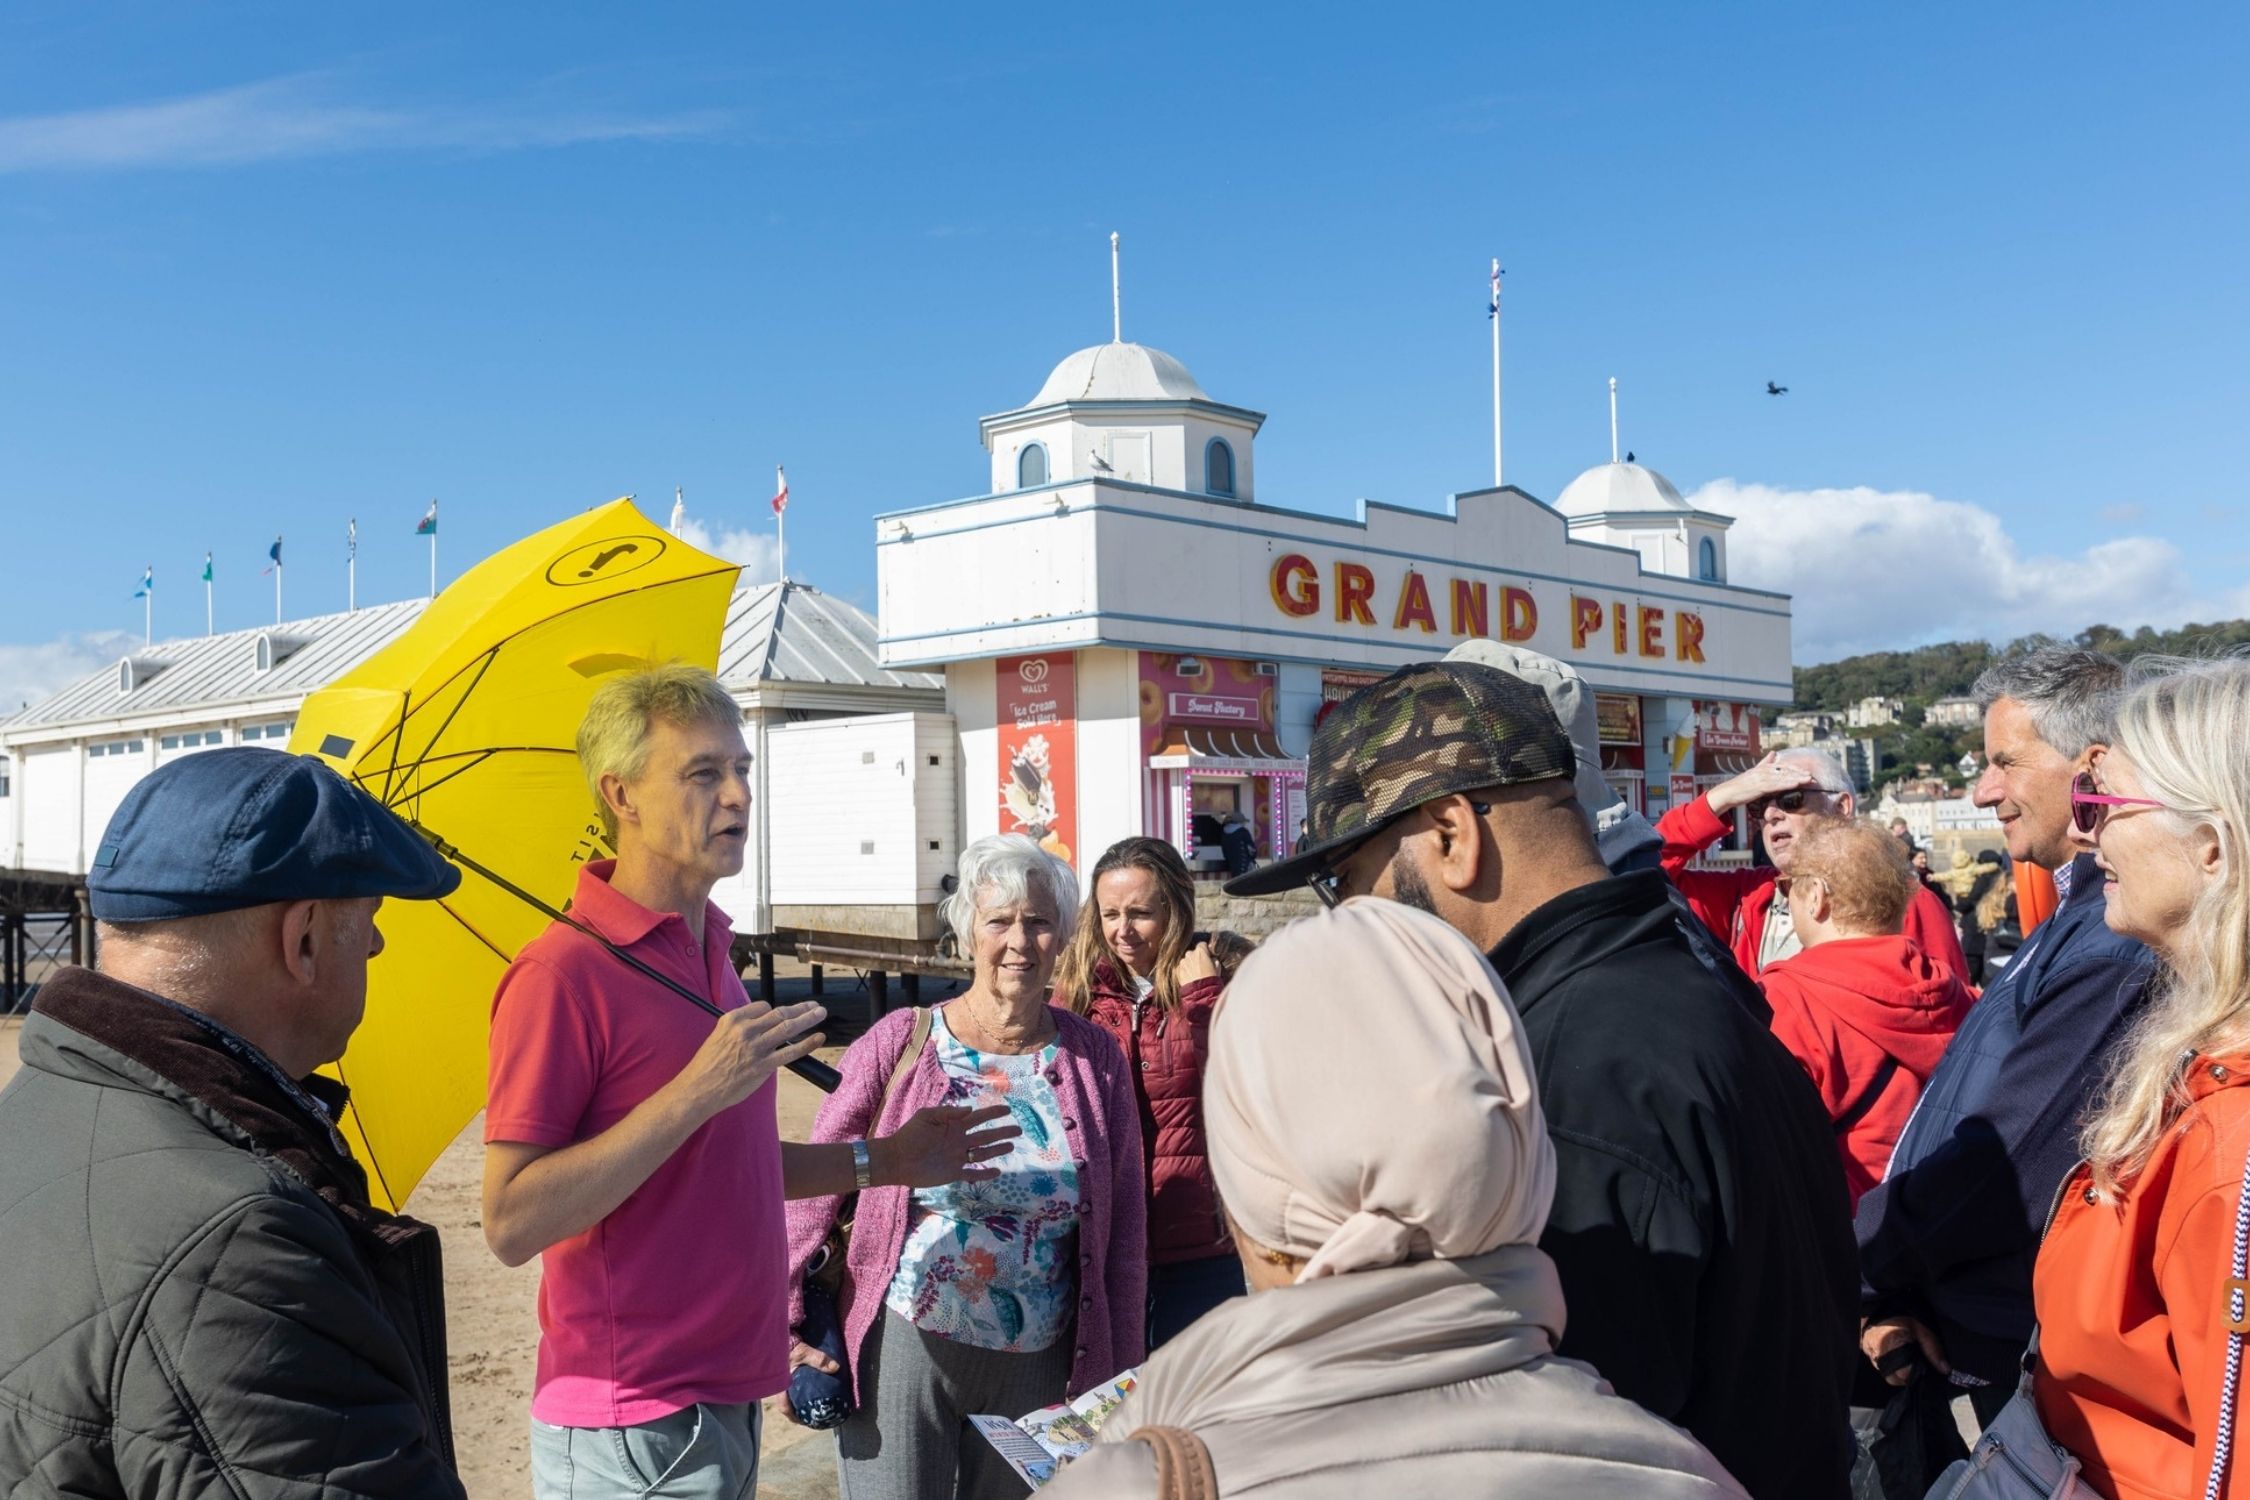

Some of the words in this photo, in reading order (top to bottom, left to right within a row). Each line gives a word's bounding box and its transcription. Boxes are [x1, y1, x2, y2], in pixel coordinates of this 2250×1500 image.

[1270, 554, 1538, 641] GRAND
[1571, 596, 1706, 663] PIER
[1021, 683, 1048, 694] WALL'S
[1013, 705, 1027, 717] Ice
[1029, 700, 1057, 714] Cream
[1187, 697, 1213, 714] Donut
[1214, 700, 1246, 718] Factory
[1016, 717, 1036, 730] Sold
[1037, 713, 1057, 725] Here
